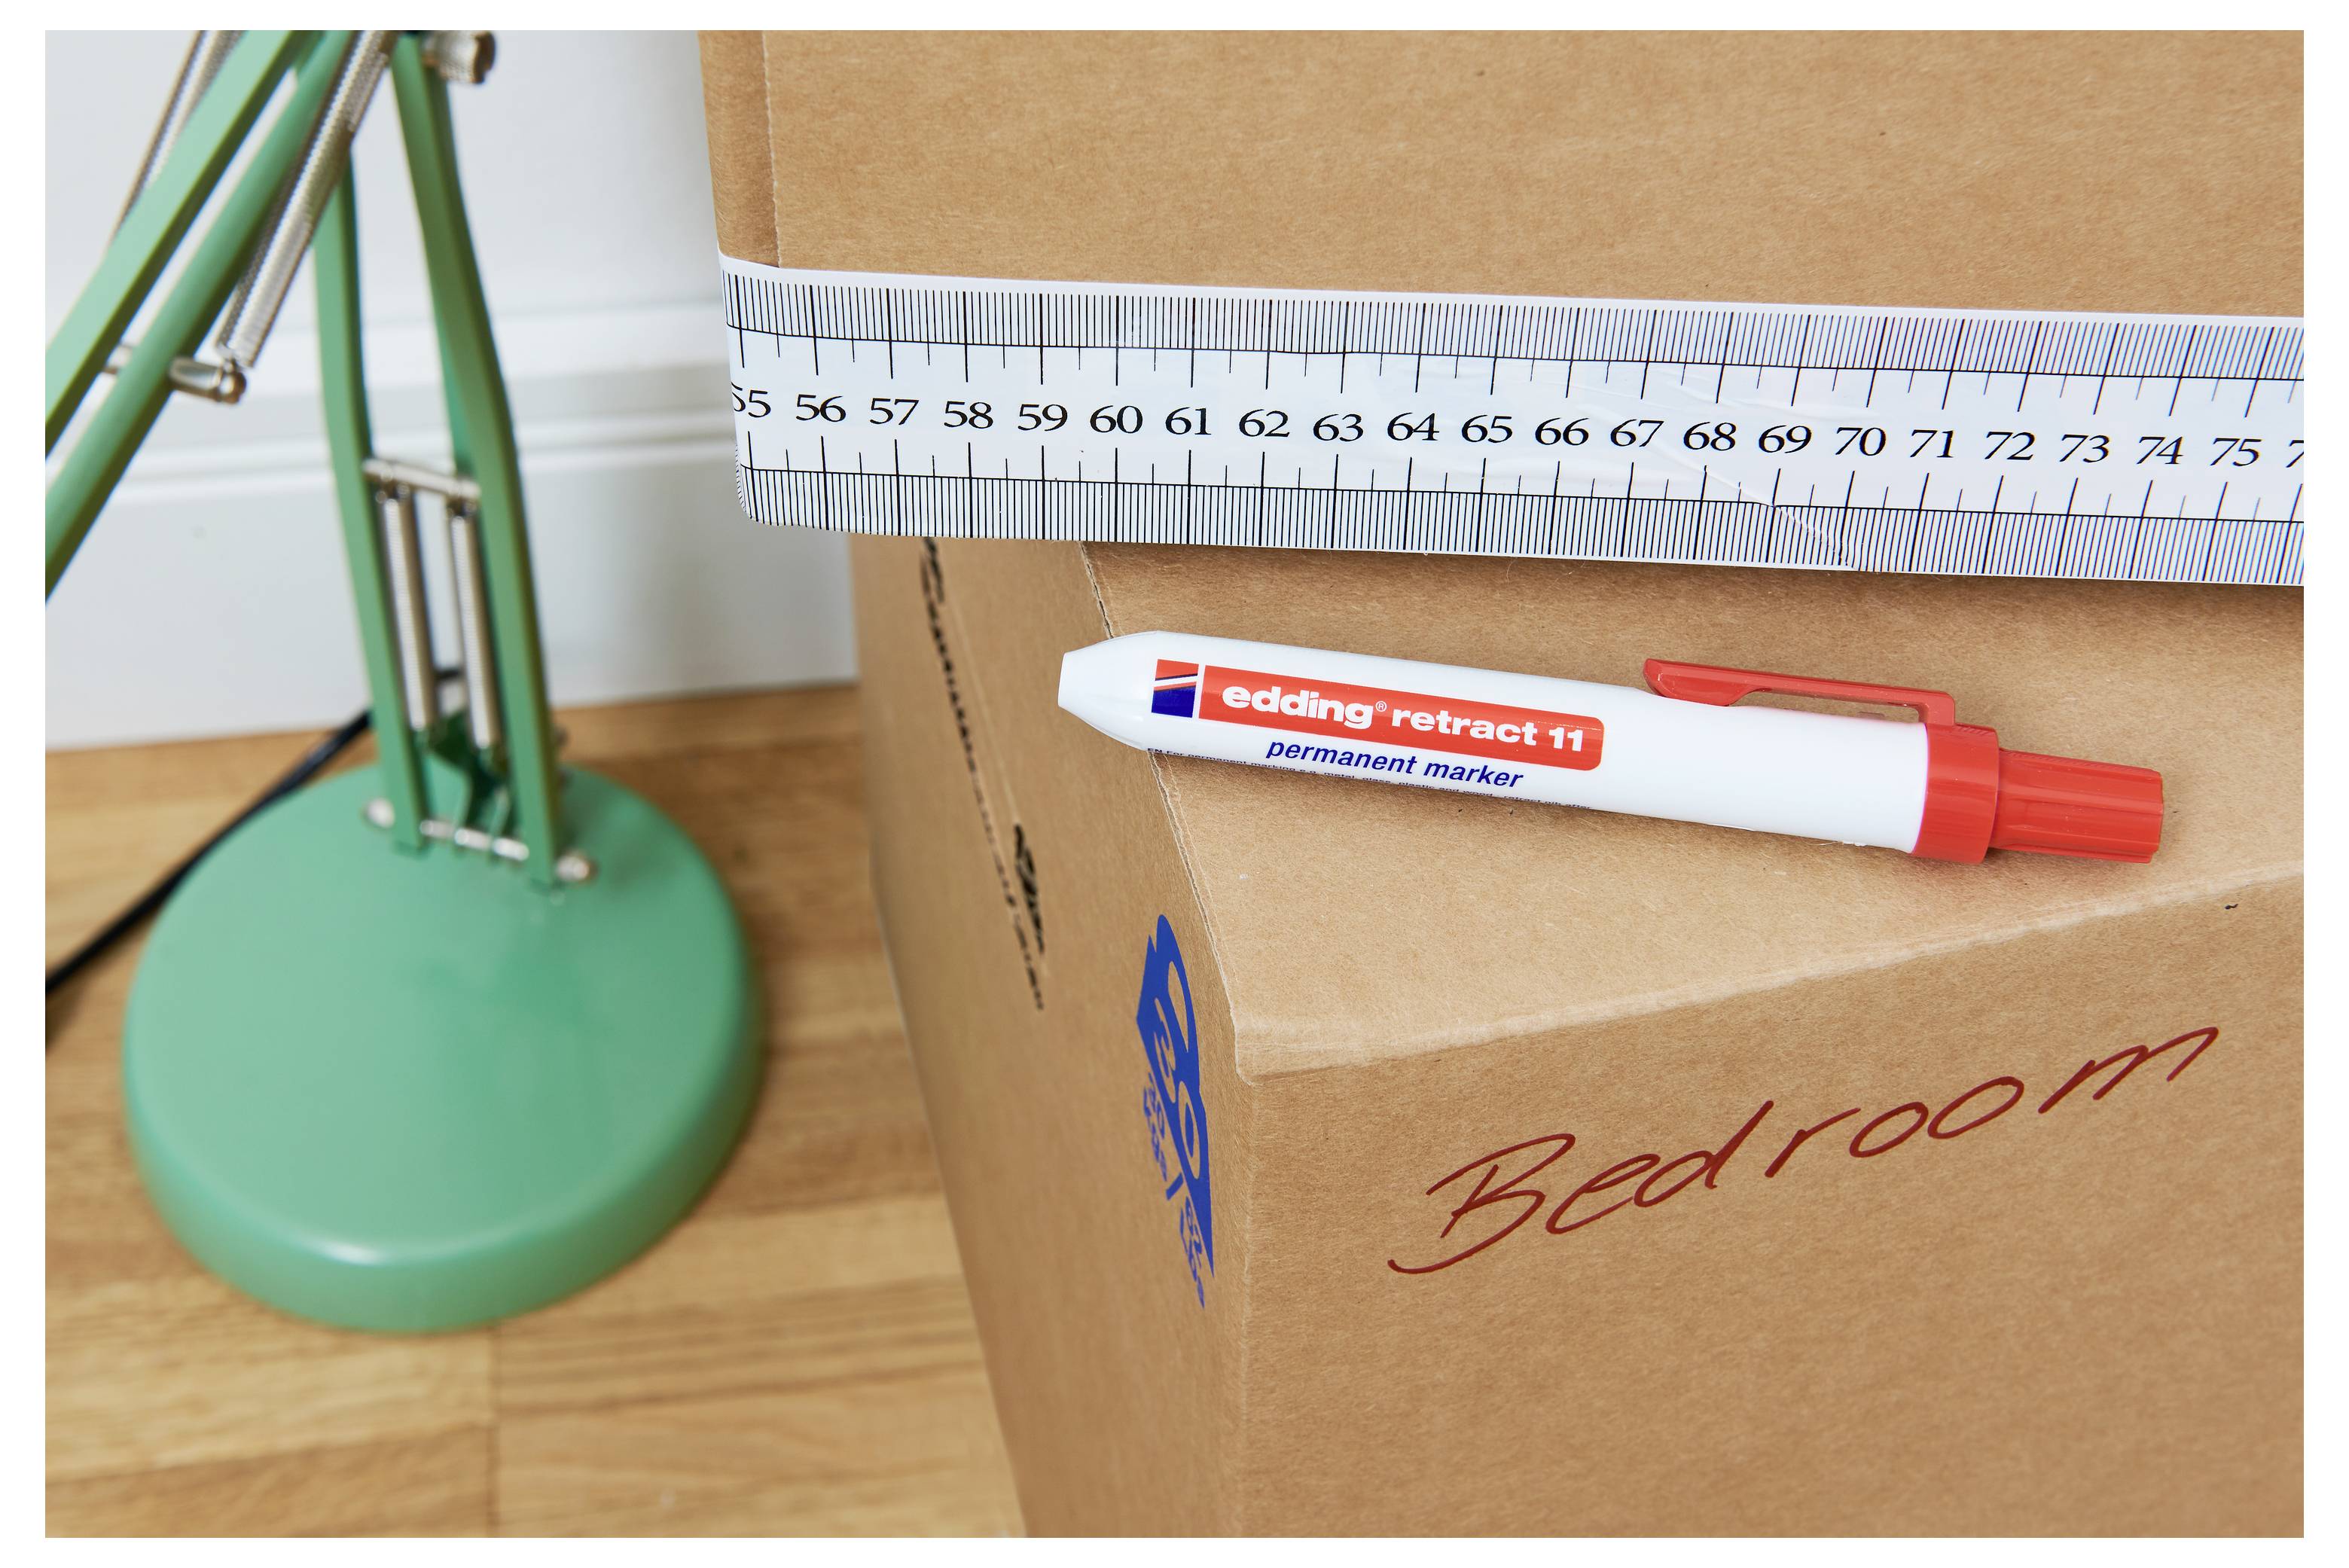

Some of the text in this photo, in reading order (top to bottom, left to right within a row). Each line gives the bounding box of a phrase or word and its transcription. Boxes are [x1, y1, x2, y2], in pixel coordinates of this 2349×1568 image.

[731, 381, 2305, 468] 55 56 57 58 59 60 61 62 63 64 65 66 67 68 69 70 71 72 73 74 75 7
[1266, 739, 1524, 788] permanent marker
[1392, 706, 1538, 747] retract
[1548, 726, 1584, 752] 11
[1153, 997, 1201, 1180] 30
[1387, 1027, 2219, 1275] Bedroom
